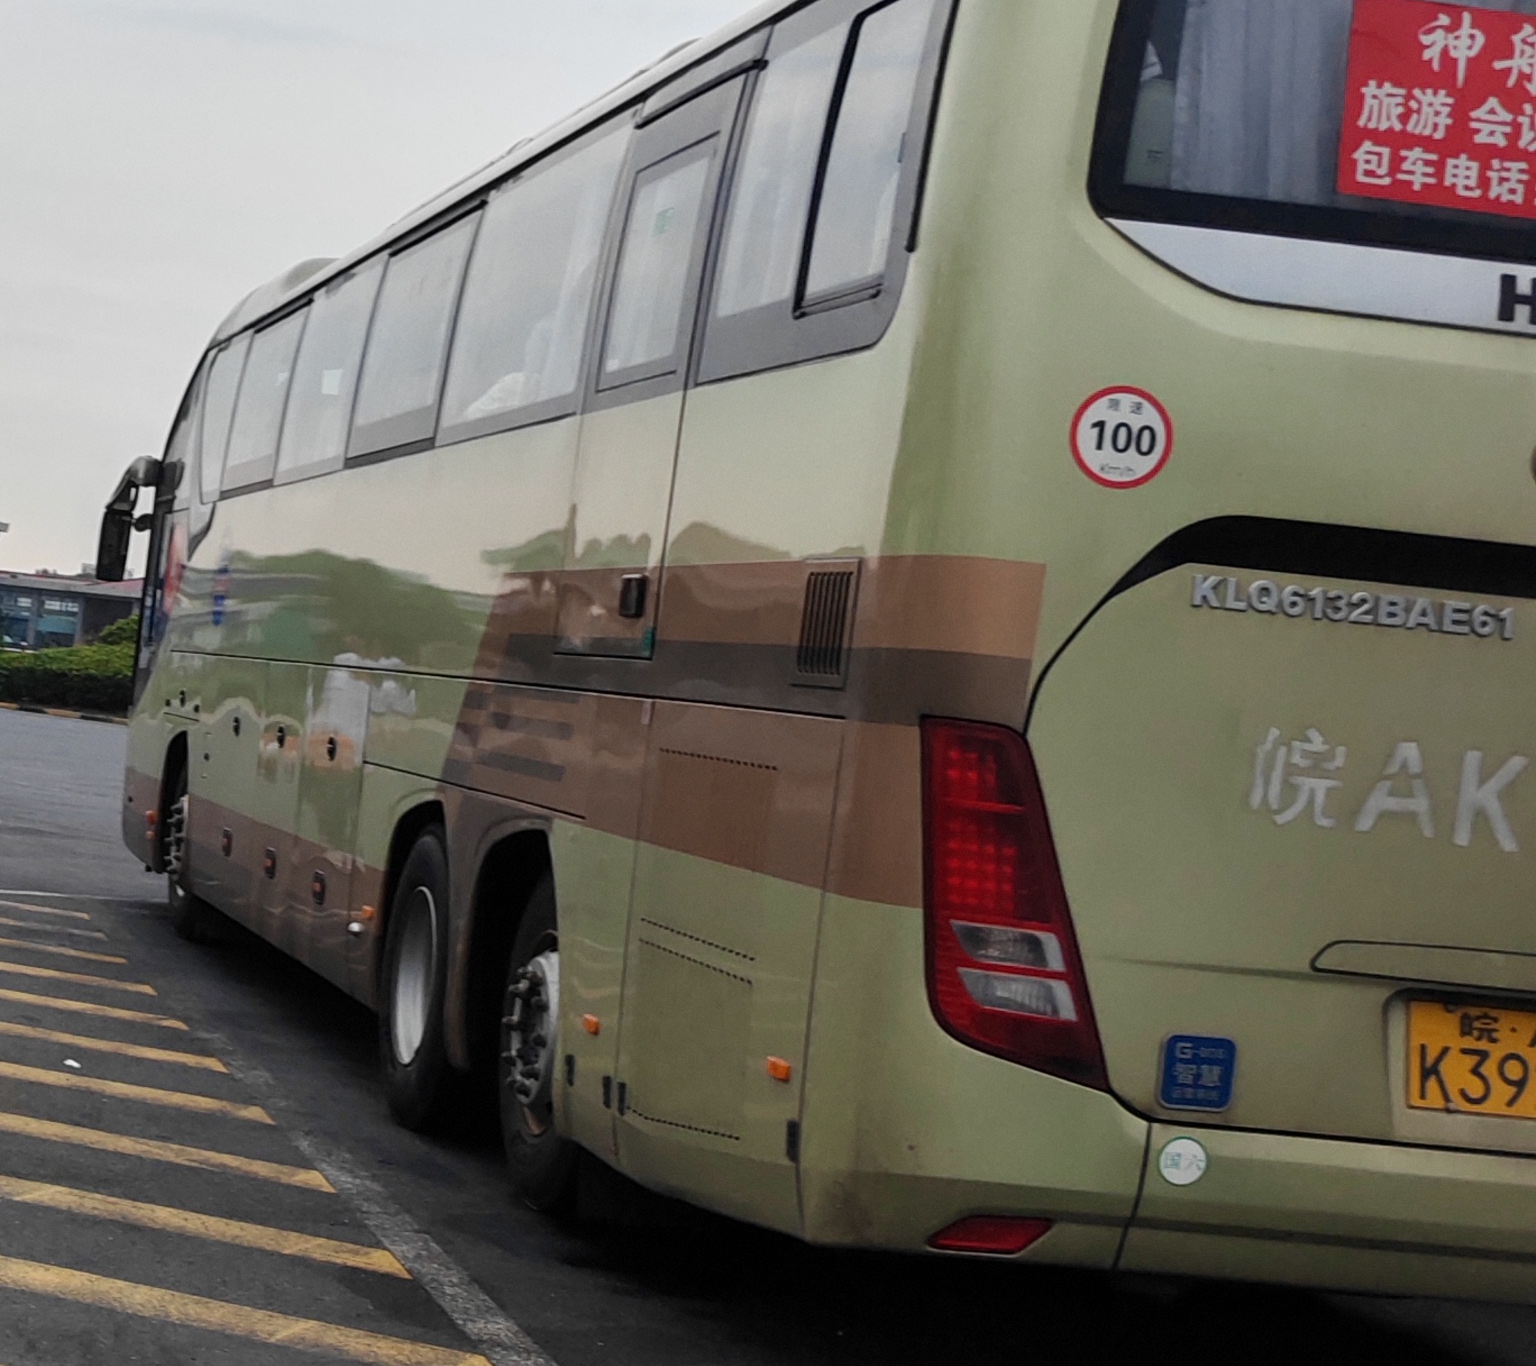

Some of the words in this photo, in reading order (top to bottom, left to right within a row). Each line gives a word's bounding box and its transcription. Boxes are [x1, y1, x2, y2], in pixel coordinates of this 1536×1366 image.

[1357, 79, 1455, 141] 旅游
[1350, 139, 1531, 206] 包车电话
[1090, 419, 1157, 457] 100
[1191, 573, 1513, 640] KLQ6132BAE61
[1419, 1043, 1530, 1107] K39
